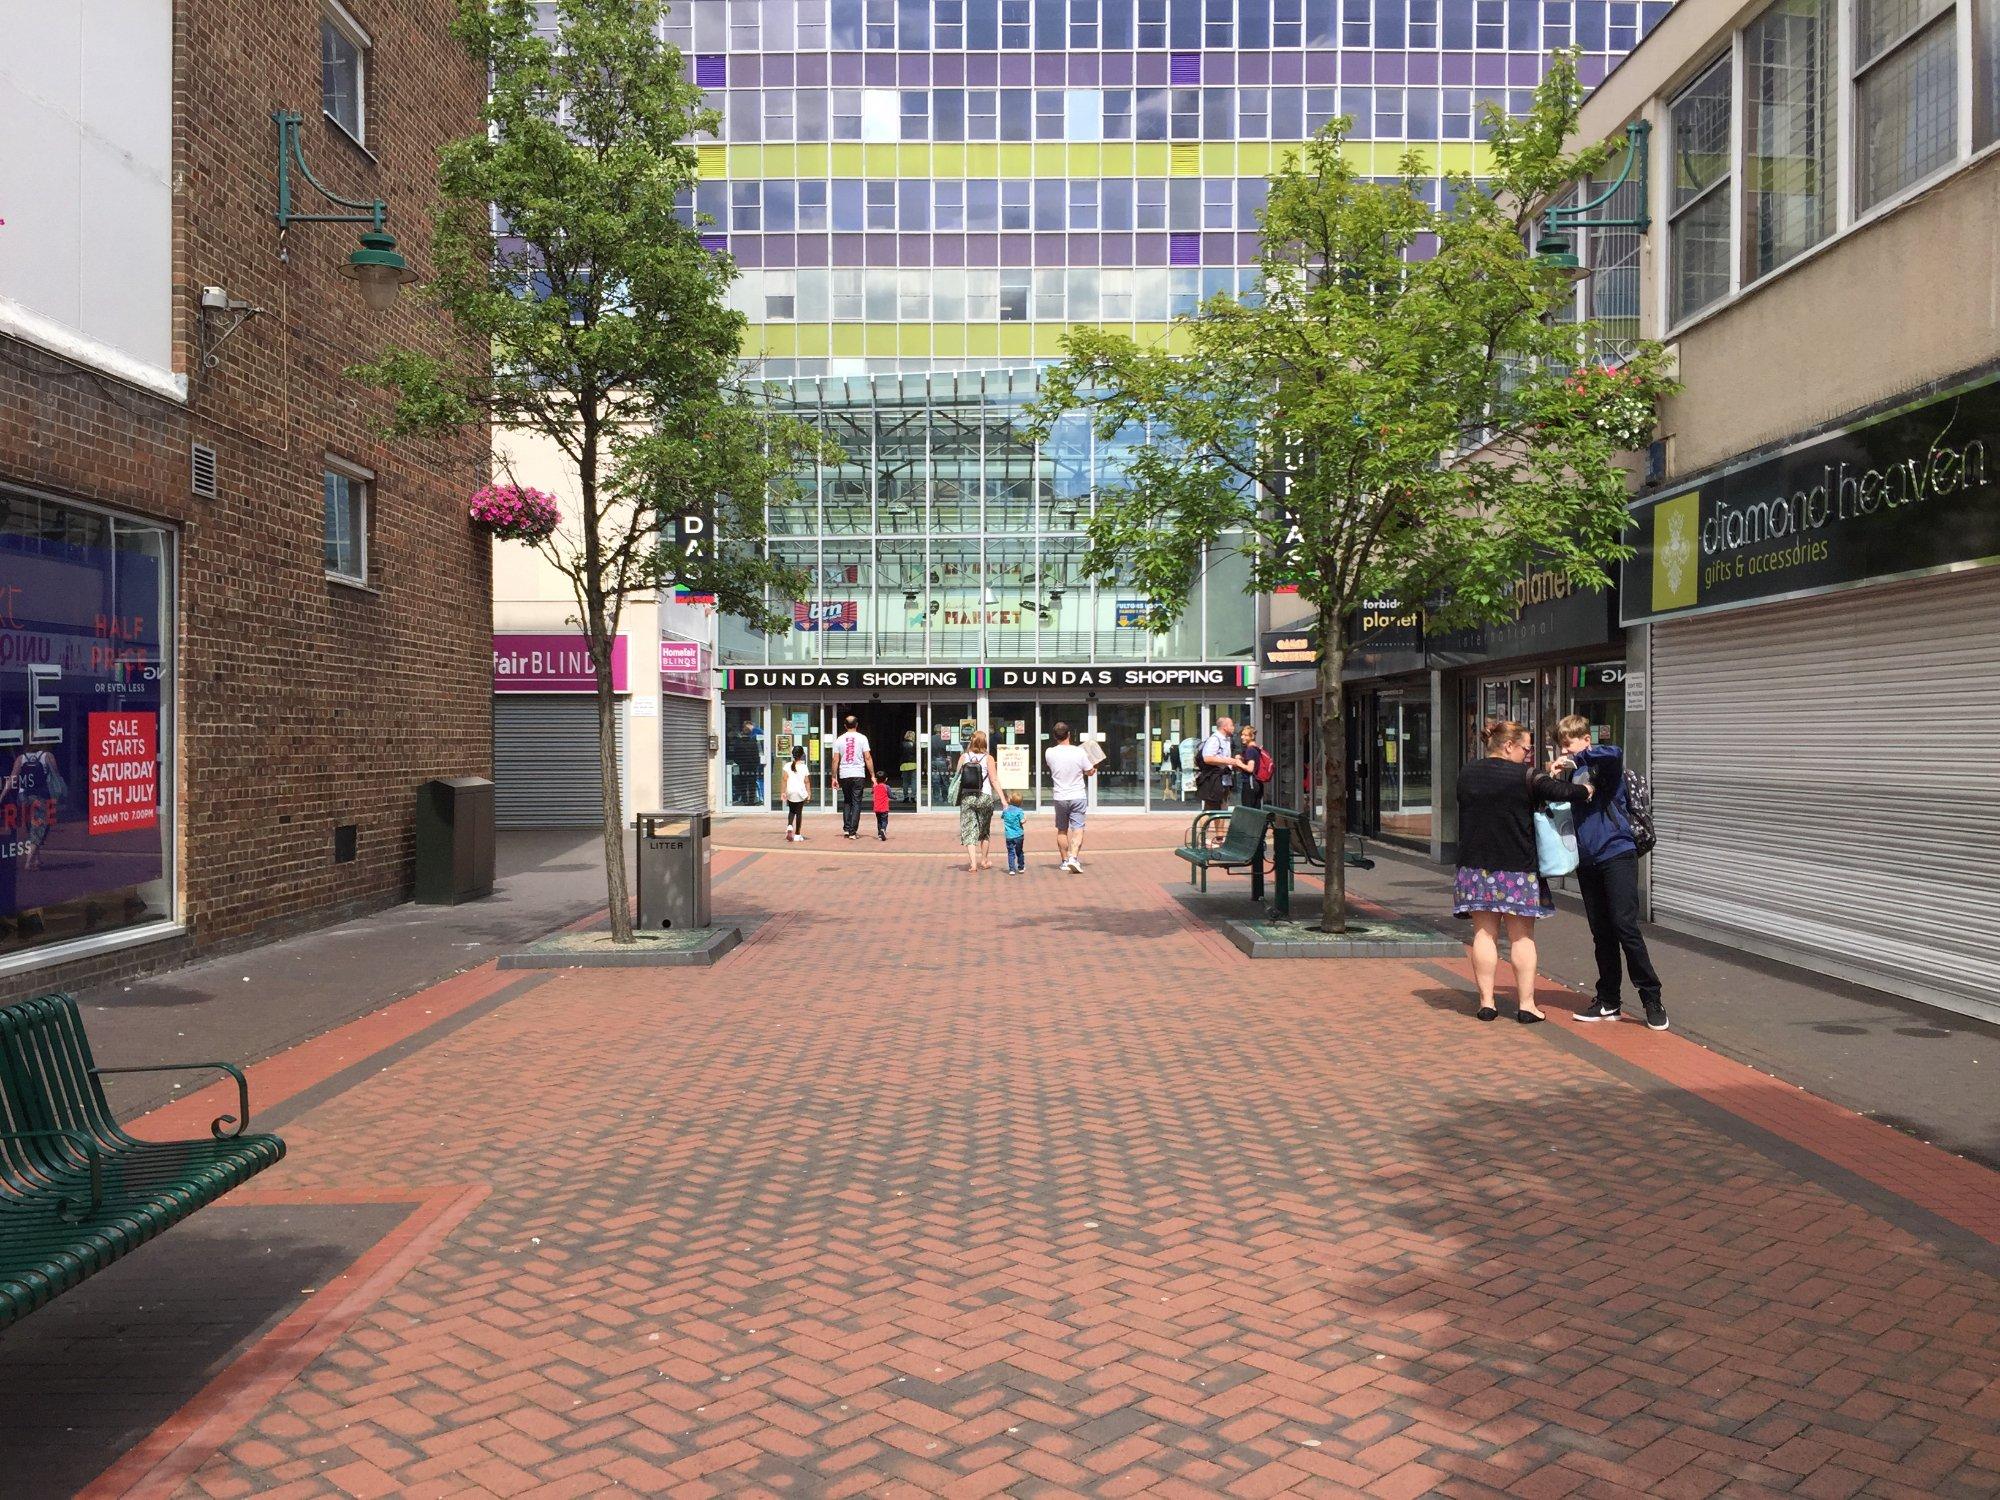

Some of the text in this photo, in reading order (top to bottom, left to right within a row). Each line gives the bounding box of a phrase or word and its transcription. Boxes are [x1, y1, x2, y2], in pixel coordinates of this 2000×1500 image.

[1703, 397, 1988, 555] diamond heaven
[1705, 540, 1829, 589] gifts & accessories
[95, 613, 144, 640] HALF
[662, 648, 696, 656] Homefair
[662, 657, 696, 666] BLINDS
[744, 672, 957, 686] DUNDAS SHOPPING
[1003, 670, 1224, 685] DUNDAS SHOPPING
[95, 684, 145, 692] OR EVEN LESS
[109, 720, 138, 736] SALE
[102, 739, 145, 756] STARTS
[91, 761, 154, 782] SATURDAY
[93, 784, 154, 807] 15TH JULY
[93, 809, 154, 825] 5.00AM TO 7.00PM
[1, 841, 32, 859] LESS
